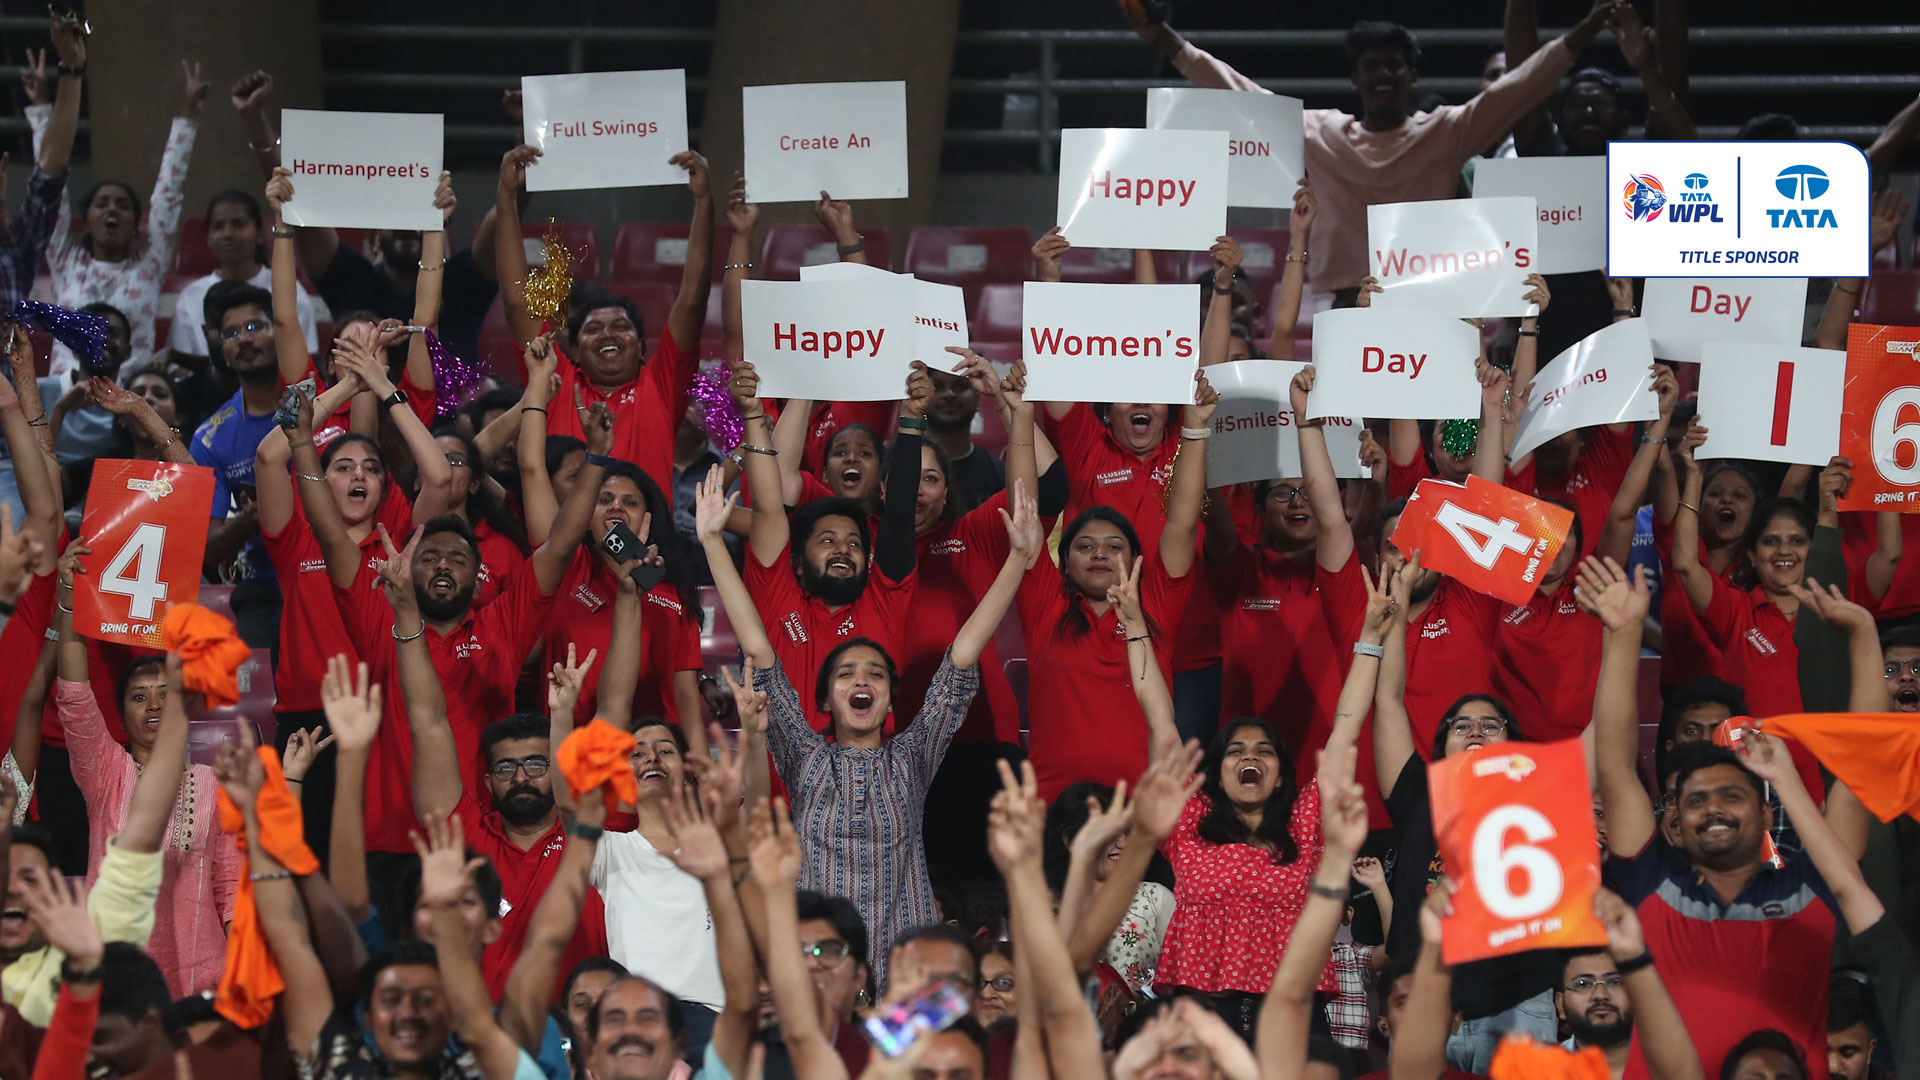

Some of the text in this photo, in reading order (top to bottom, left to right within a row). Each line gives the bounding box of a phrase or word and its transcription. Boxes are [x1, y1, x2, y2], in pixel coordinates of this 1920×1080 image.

[552, 118, 658, 138] Full Swings
[779, 133, 871, 151] Create An
[1229, 139, 1270, 157] SION
[293, 158, 430, 181] Harmanpreet's
[1089, 170, 1196, 208] Happy
[1536, 204, 1582, 226] agic!
[1376, 240, 1531, 278] Women's
[1690, 285, 1752, 323] Day
[774, 322, 885, 359] Happy
[1030, 328, 1193, 358] Women's
[1362, 346, 1428, 380] Day
[1543, 367, 1607, 407] Strong
[1770, 361, 1795, 447] I
[1871, 386, 1920, 486] 6
[1096, 468, 1133, 480] ILLUSION
[1874, 490, 1905, 505] BRING
[1433, 499, 1536, 571] 4
[98, 521, 169, 622] 4
[1521, 537, 1549, 583] BRING IT ON
[579, 584, 604, 606] ILLUSION
[100, 622, 157, 635] BRING IT ON
[790, 612, 808, 643] ILLUSION
[1751, 628, 1777, 654] ILLUSION
[1471, 804, 1565, 921] 6
